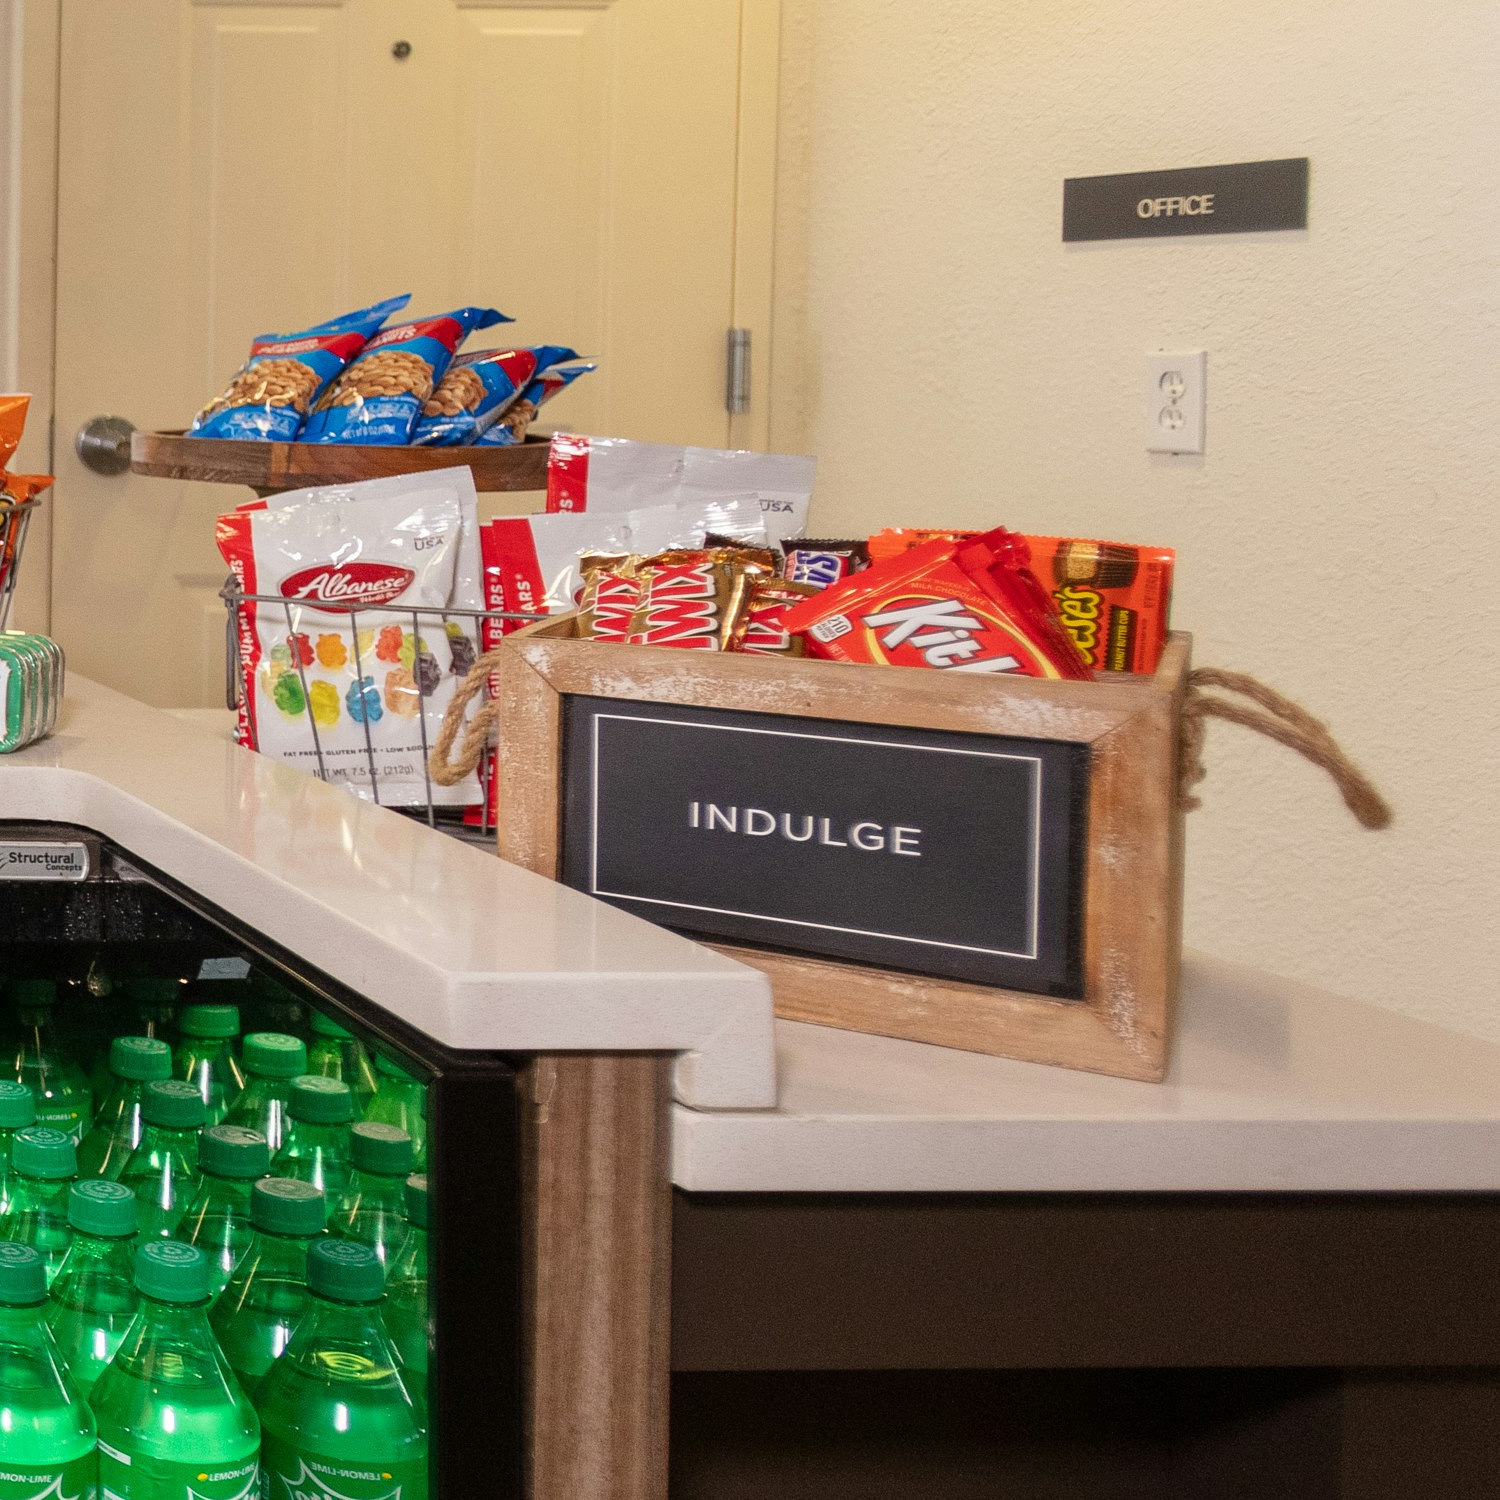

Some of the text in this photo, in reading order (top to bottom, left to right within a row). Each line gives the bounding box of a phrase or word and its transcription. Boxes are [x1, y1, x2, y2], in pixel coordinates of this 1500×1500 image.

[1137, 194, 1215, 218] OFFICE
[413, 537, 445, 552] USA
[294, 572, 407, 600] Albanese
[935, 585, 986, 607] CHOCOLATE
[861, 599, 986, 668] Kit
[358, 747, 377, 755] FRE
[351, 766, 366, 776] 7.5
[689, 801, 922, 857] INDULGE
[8, 852, 74, 864] Structural
[45, 864, 82, 872] Concepts
[208, 1462, 255, 1482] LEMON-LIME
